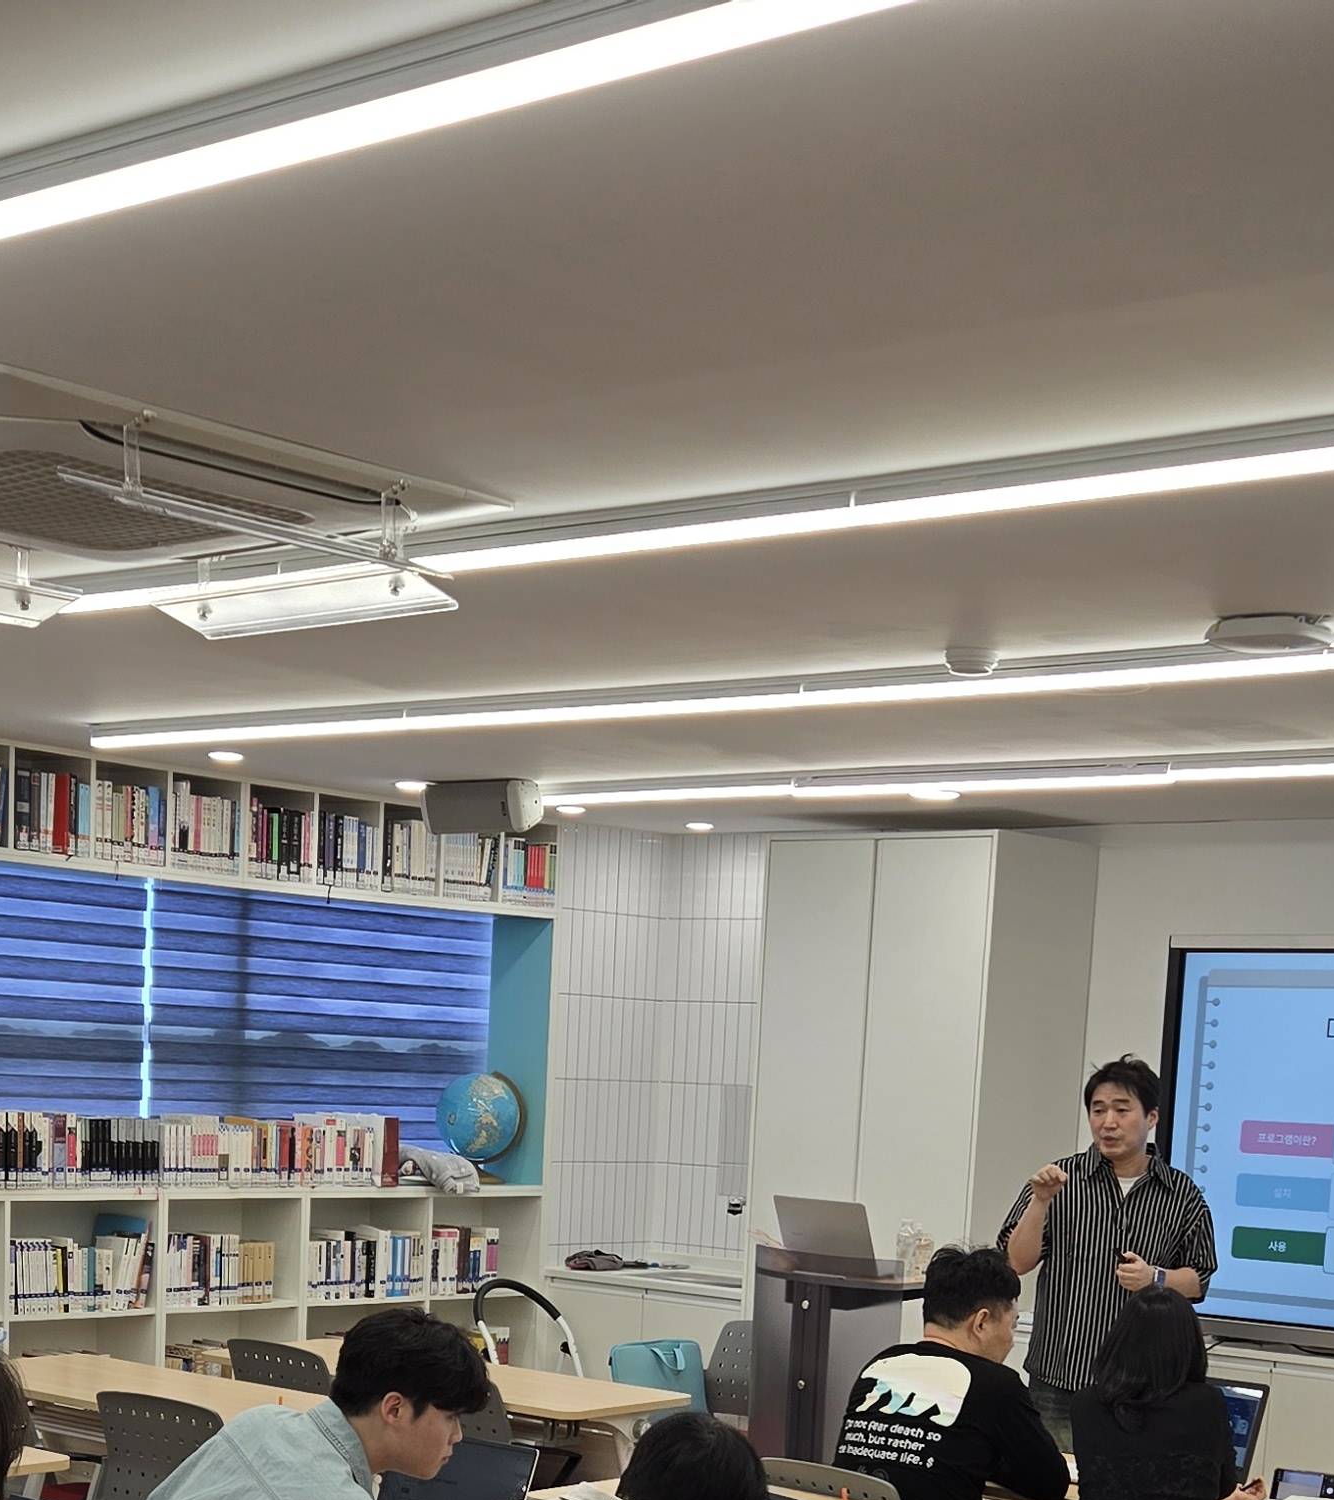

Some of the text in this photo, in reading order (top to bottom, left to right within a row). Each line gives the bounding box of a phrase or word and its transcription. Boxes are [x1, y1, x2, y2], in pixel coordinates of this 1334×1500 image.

[1257, 1133, 1318, 1147] 프로그램이란?
[1273, 1187, 1292, 1199] 설치
[1268, 1240, 1287, 1253] 사용
[868, 1421, 889, 1431] fear
[889, 1424, 925, 1438] death
[926, 1432, 942, 1441] so
[868, 1433, 886, 1445] but
[887, 1438, 926, 1451] rather
[900, 1452, 923, 1465] life.
